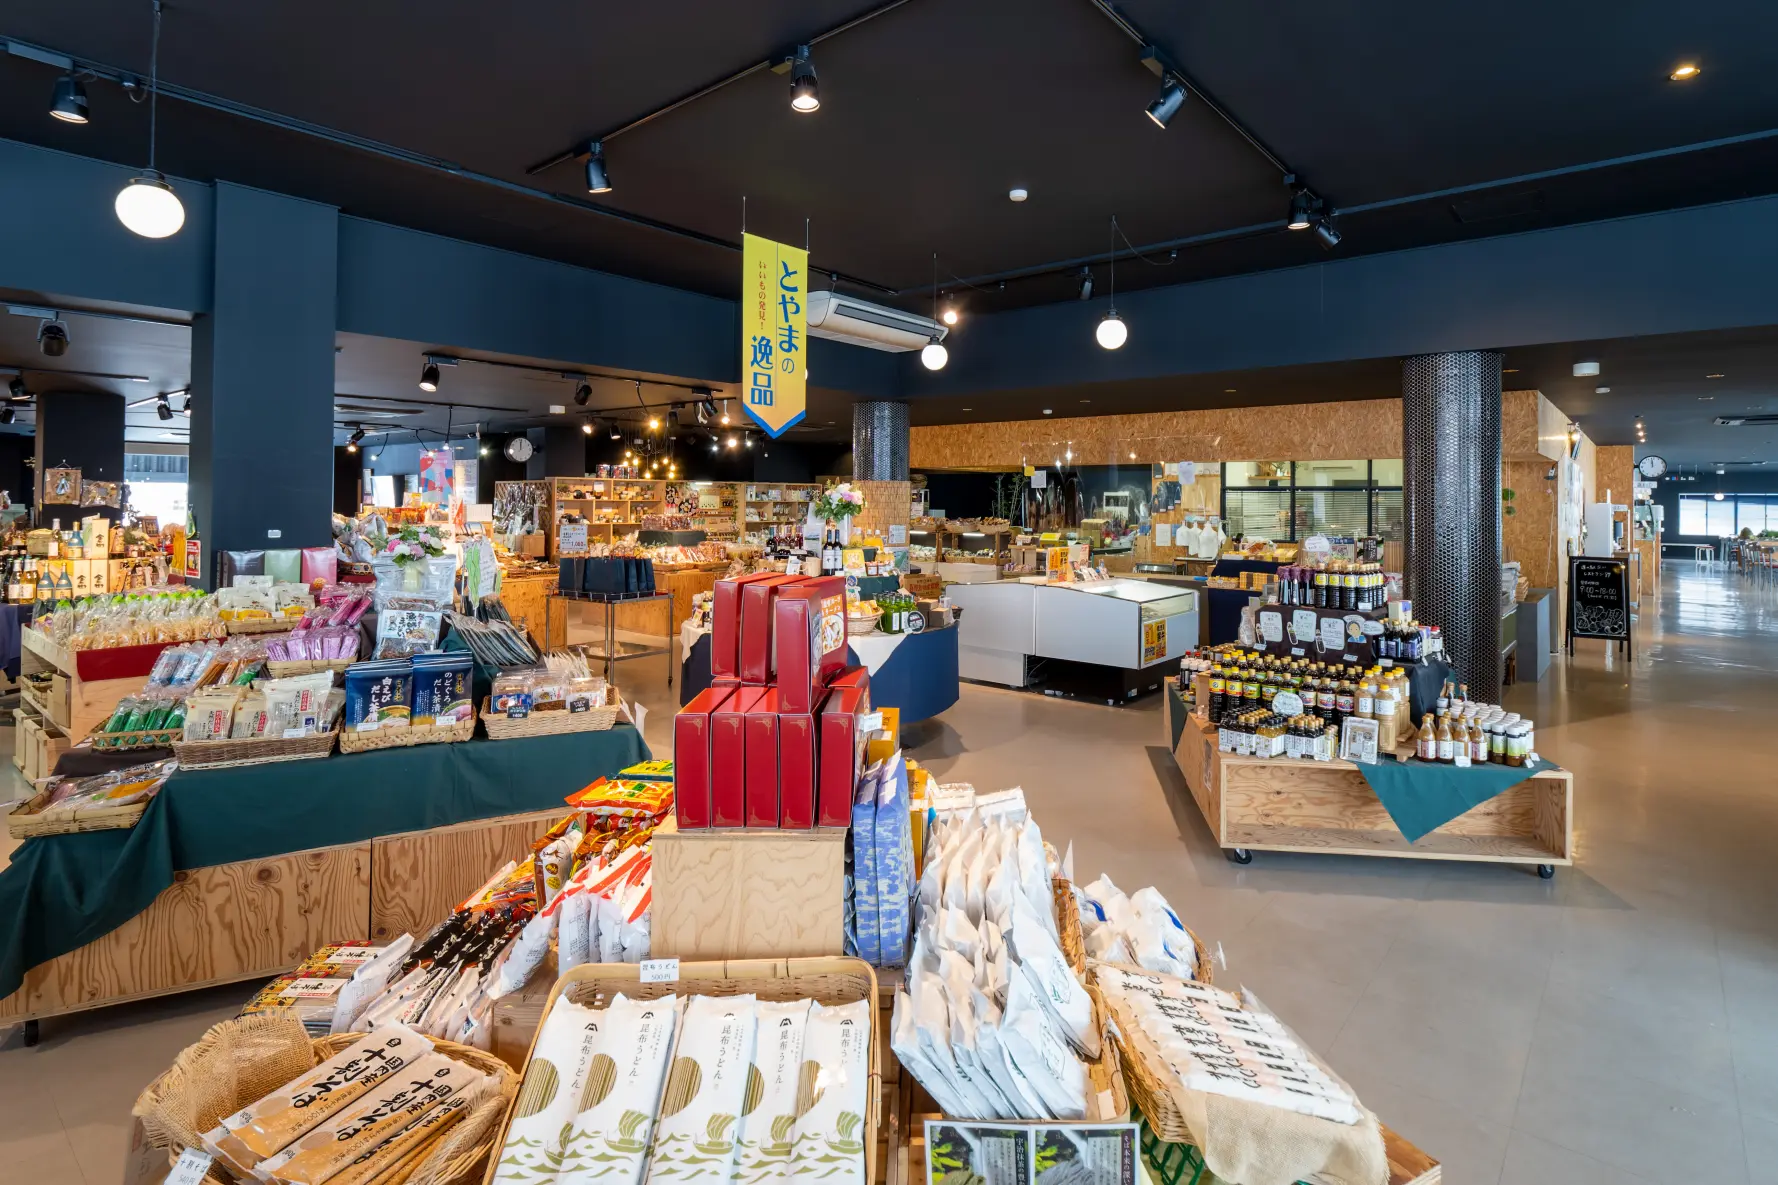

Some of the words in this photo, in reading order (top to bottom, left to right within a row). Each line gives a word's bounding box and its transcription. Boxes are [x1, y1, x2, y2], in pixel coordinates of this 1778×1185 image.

[750, 335, 774, 406] 逸品
[381, 677, 393, 703] 白えび
[443, 672, 453, 703] のどぐろ
[359, 1055, 404, 1088] 国内産
[571, 1034, 593, 1089] 昆布うどん
[628, 1023, 650, 1077] 昆布うどん
[713, 1024, 731, 1080] 昆布うどん
[776, 1029, 789, 1085] 昆布うどん
[292, 1047, 387, 1109] 十割そば
[406, 1084, 452, 1116] 国内産
[337, 1079, 434, 1142] 十割そば
